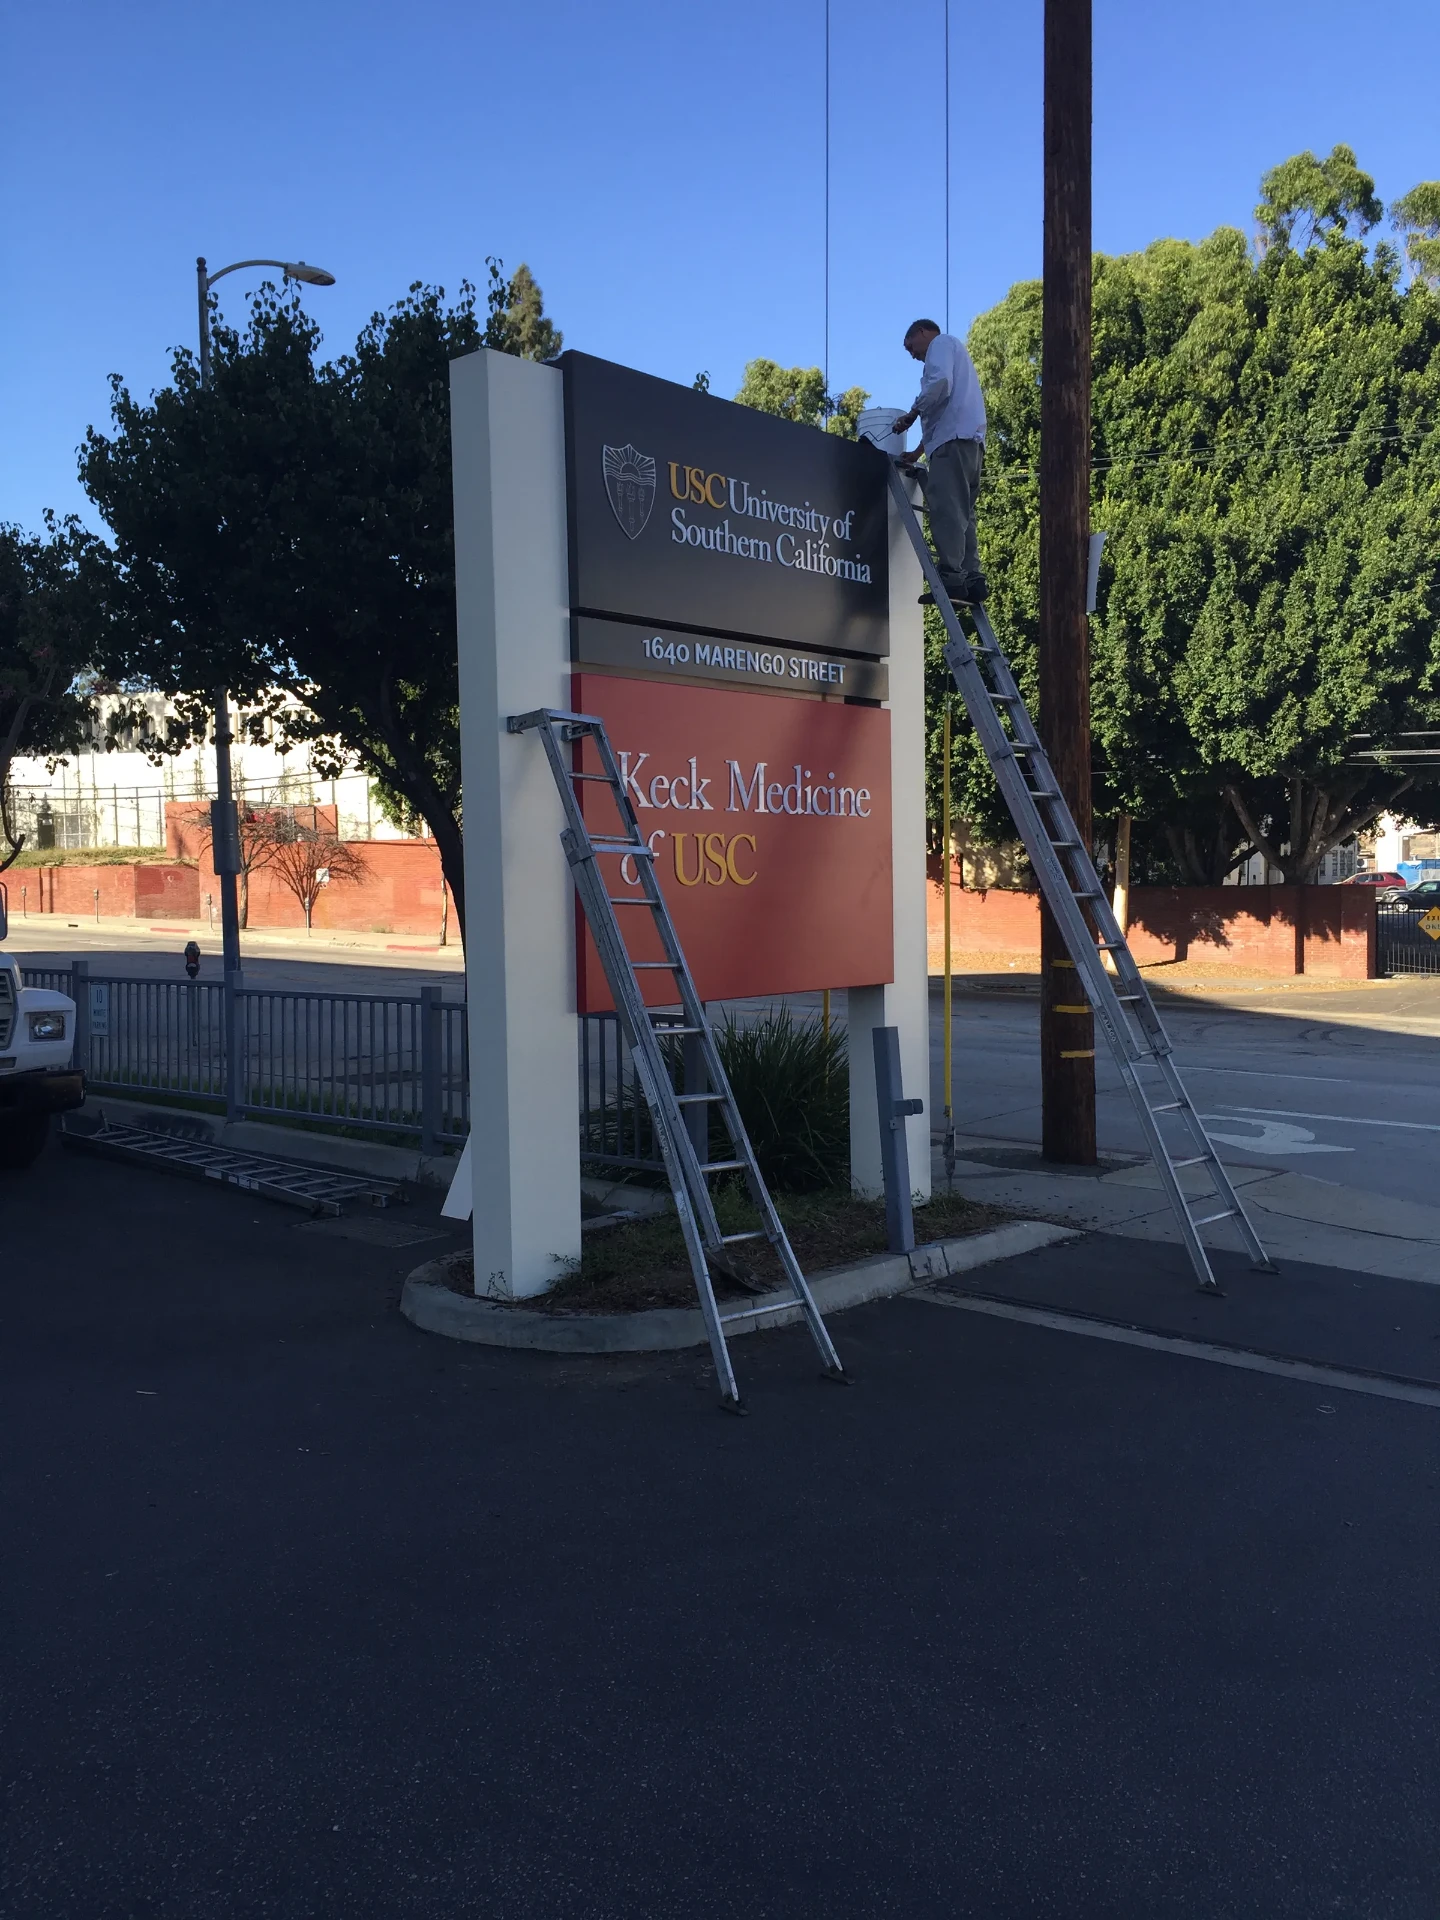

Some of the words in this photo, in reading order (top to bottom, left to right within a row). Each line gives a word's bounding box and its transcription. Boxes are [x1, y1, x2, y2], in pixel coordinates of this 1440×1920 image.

[668, 461, 727, 509] USC
[727, 477, 829, 544] University
[832, 510, 855, 541] of
[671, 507, 773, 563] Southern
[775, 533, 872, 584] California
[642, 636, 690, 665] 1640
[695, 643, 785, 676] MARENGO
[787, 657, 846, 685] STREET
[617, 751, 714, 811] Keck
[725, 759, 871, 818] Medicine
[670, 832, 757, 886] USC
[96, 989, 103, 1003] 10
